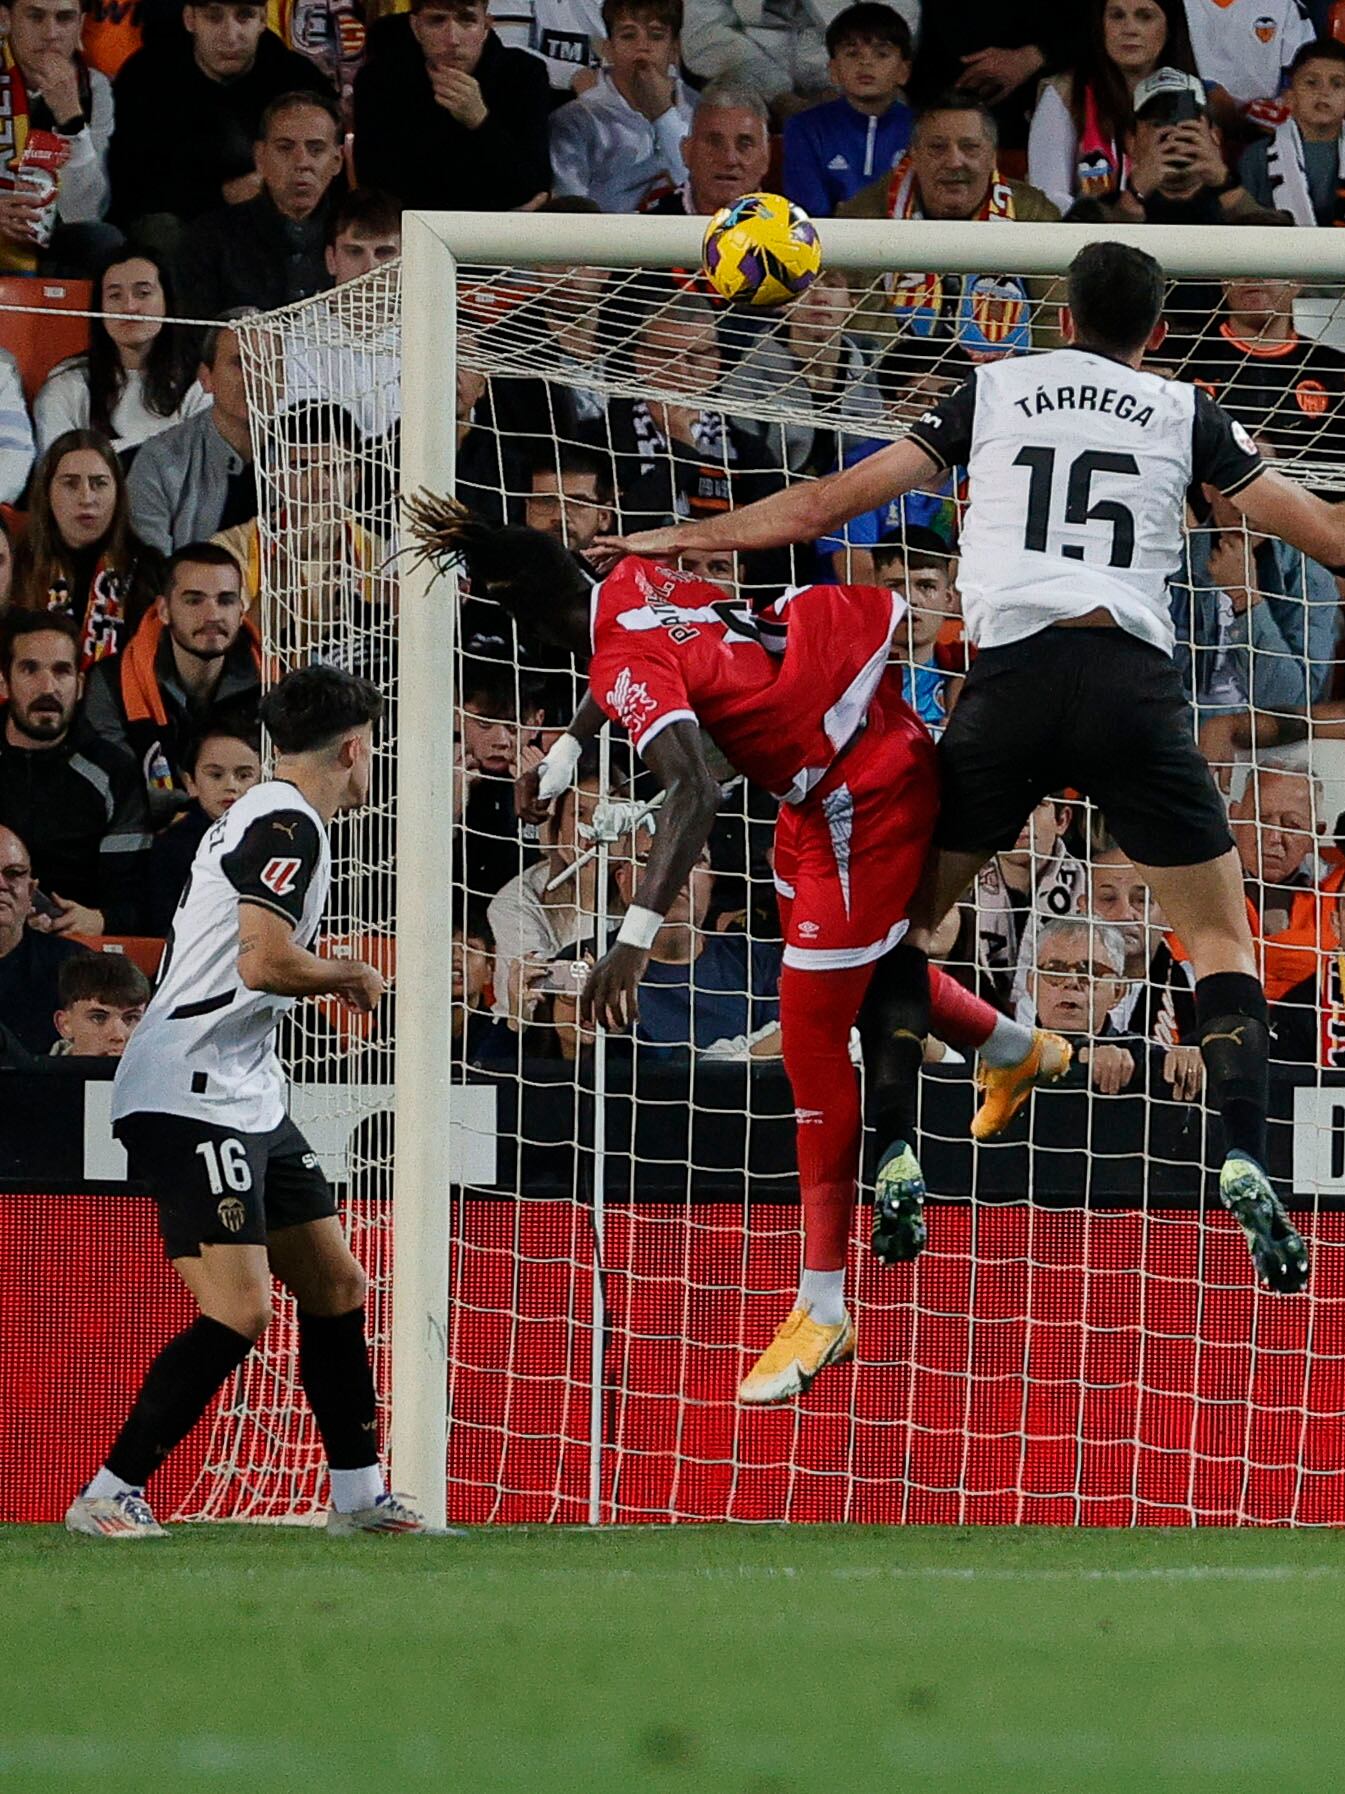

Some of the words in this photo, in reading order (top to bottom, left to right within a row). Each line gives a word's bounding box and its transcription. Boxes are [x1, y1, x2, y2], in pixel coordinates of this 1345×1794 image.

[1014, 384, 1156, 428] TÁRREGA
[1011, 445, 1141, 569] 15
[195, 1138, 252, 1195] 16
